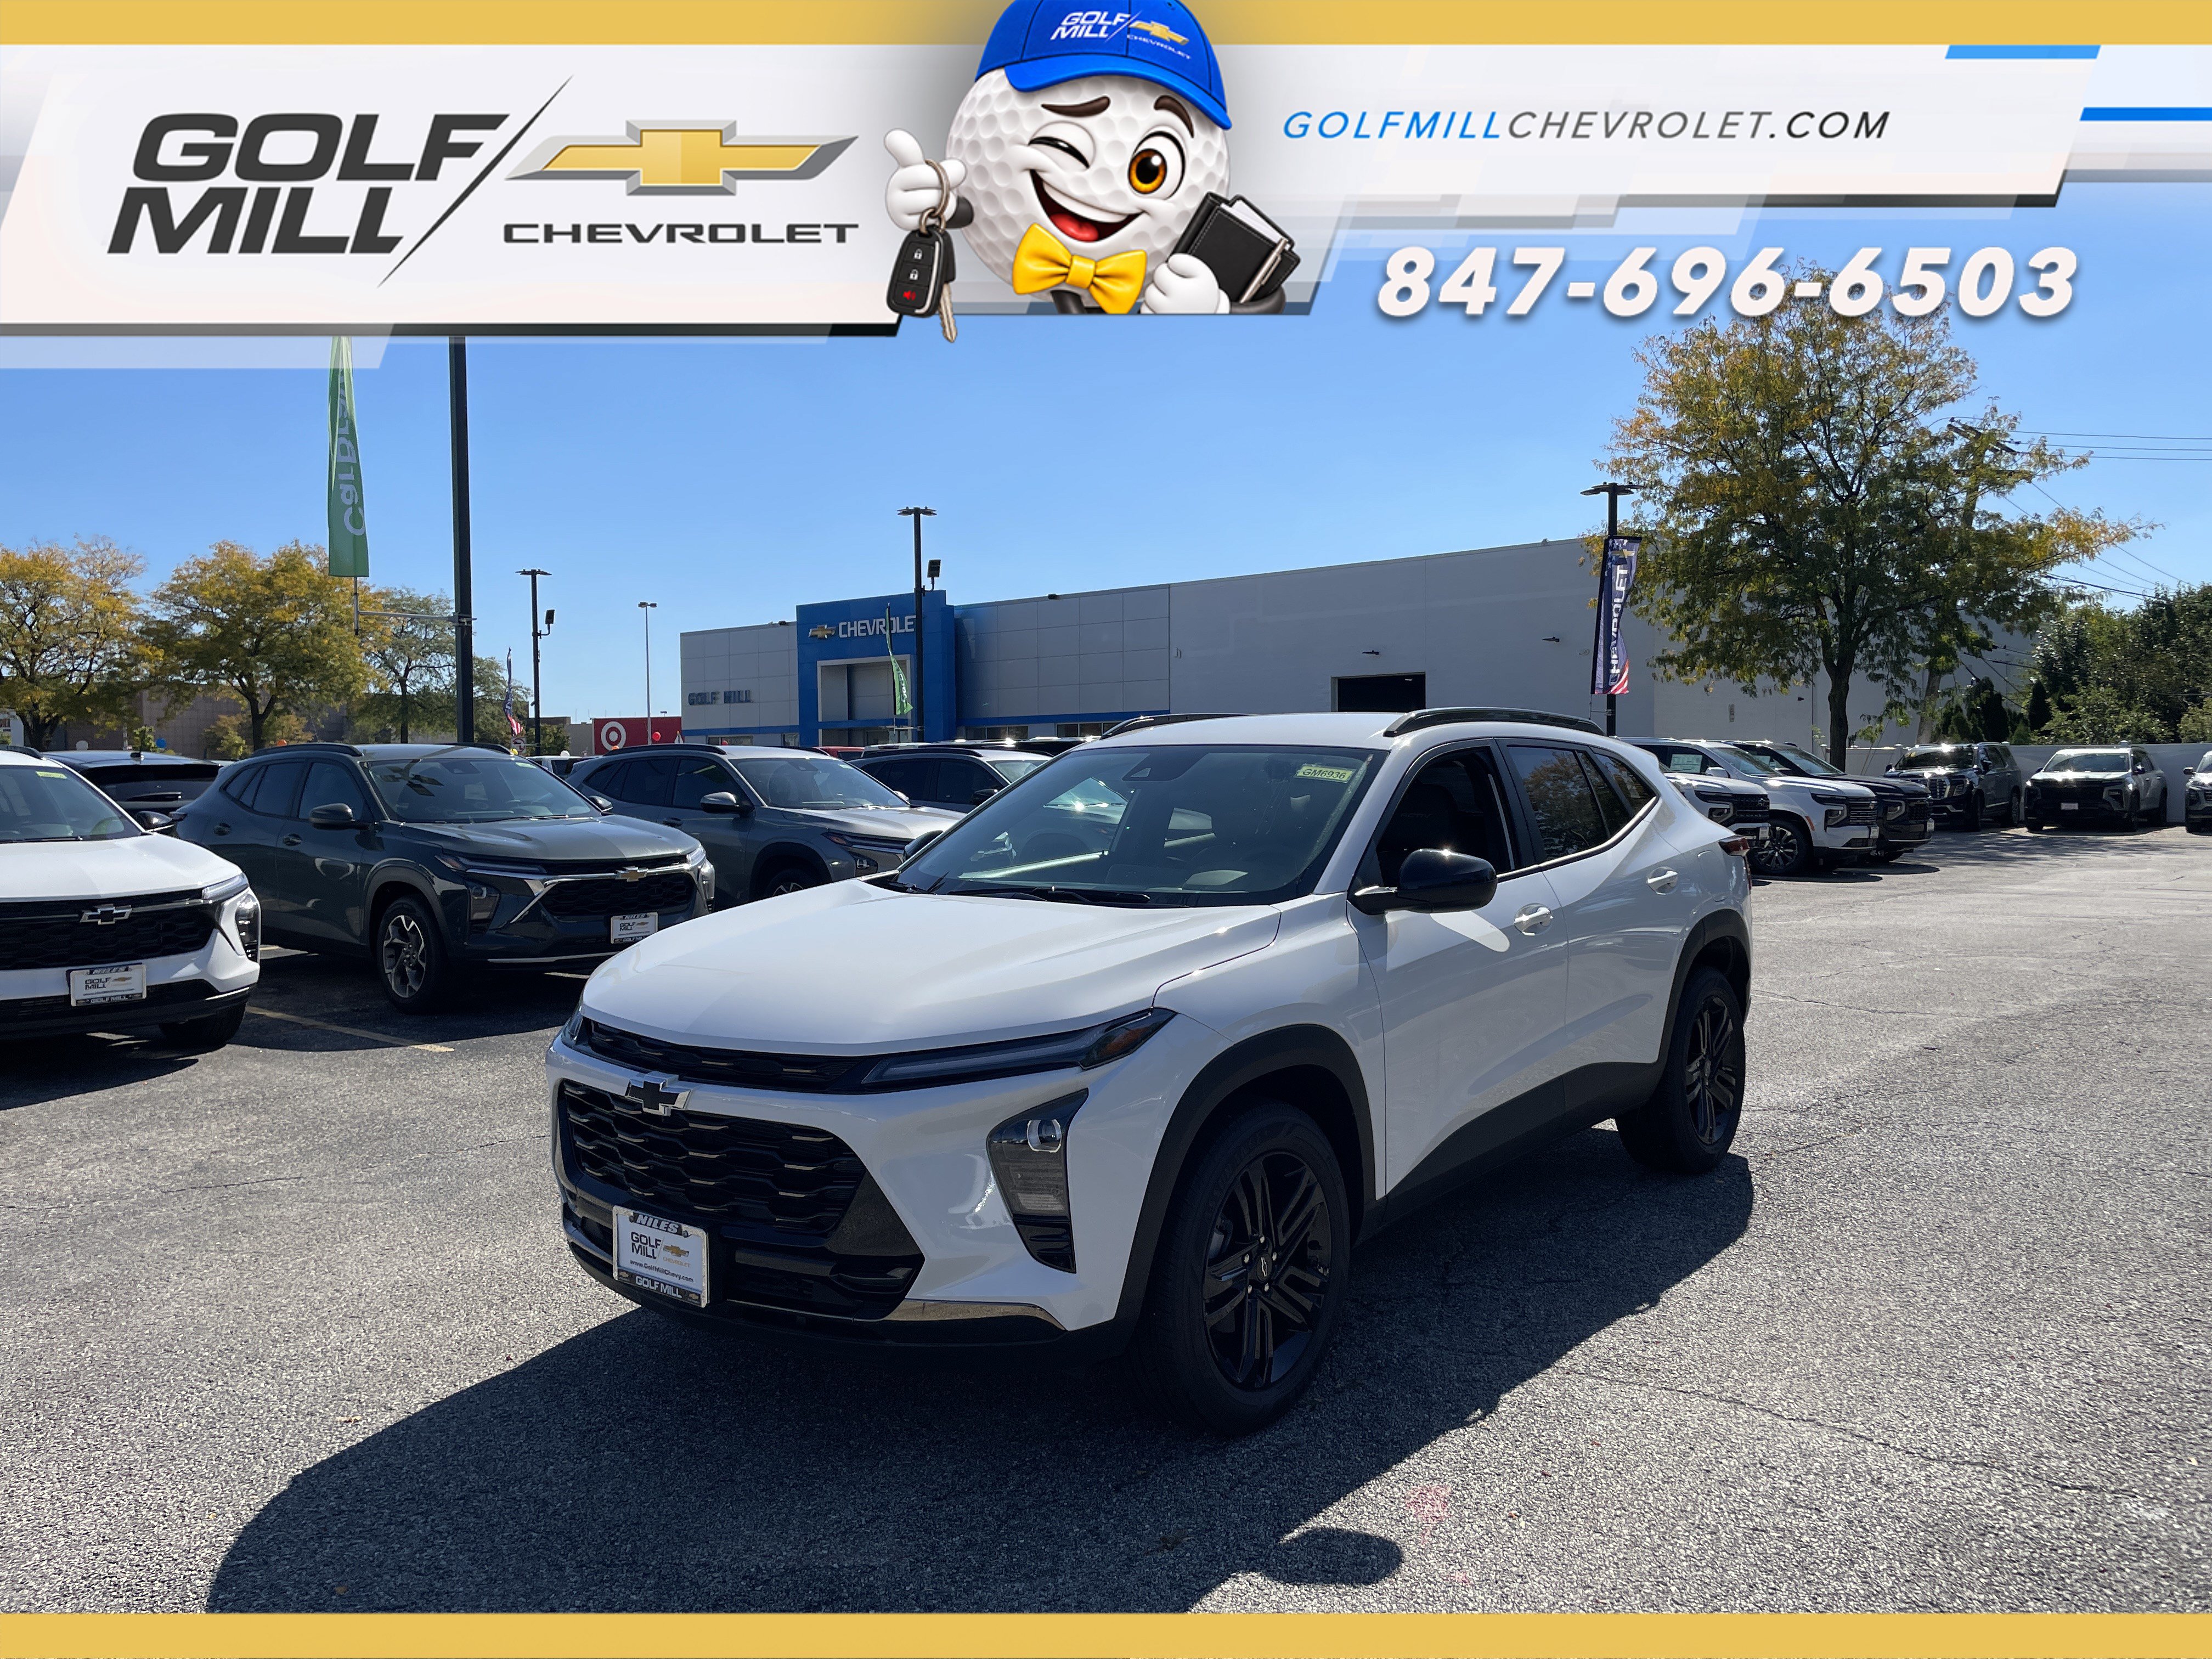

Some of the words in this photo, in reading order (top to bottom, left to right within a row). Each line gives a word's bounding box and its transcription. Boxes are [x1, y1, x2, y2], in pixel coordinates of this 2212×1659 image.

[838, 615, 916, 638] CHEVROLE
[688, 692, 720, 706] GOLF
[724, 690, 753, 704] MILL
[1302, 769, 1347, 779] GM6936
[636, 1214, 679, 1233] NILES
[631, 1232, 662, 1249] GOLF
[631, 1243, 657, 1259] MILL
[630, 1260, 694, 1283] www.GolfMillChevy.com
[635, 1276, 659, 1290] GOLF
[660, 1283, 682, 1298] MILL
